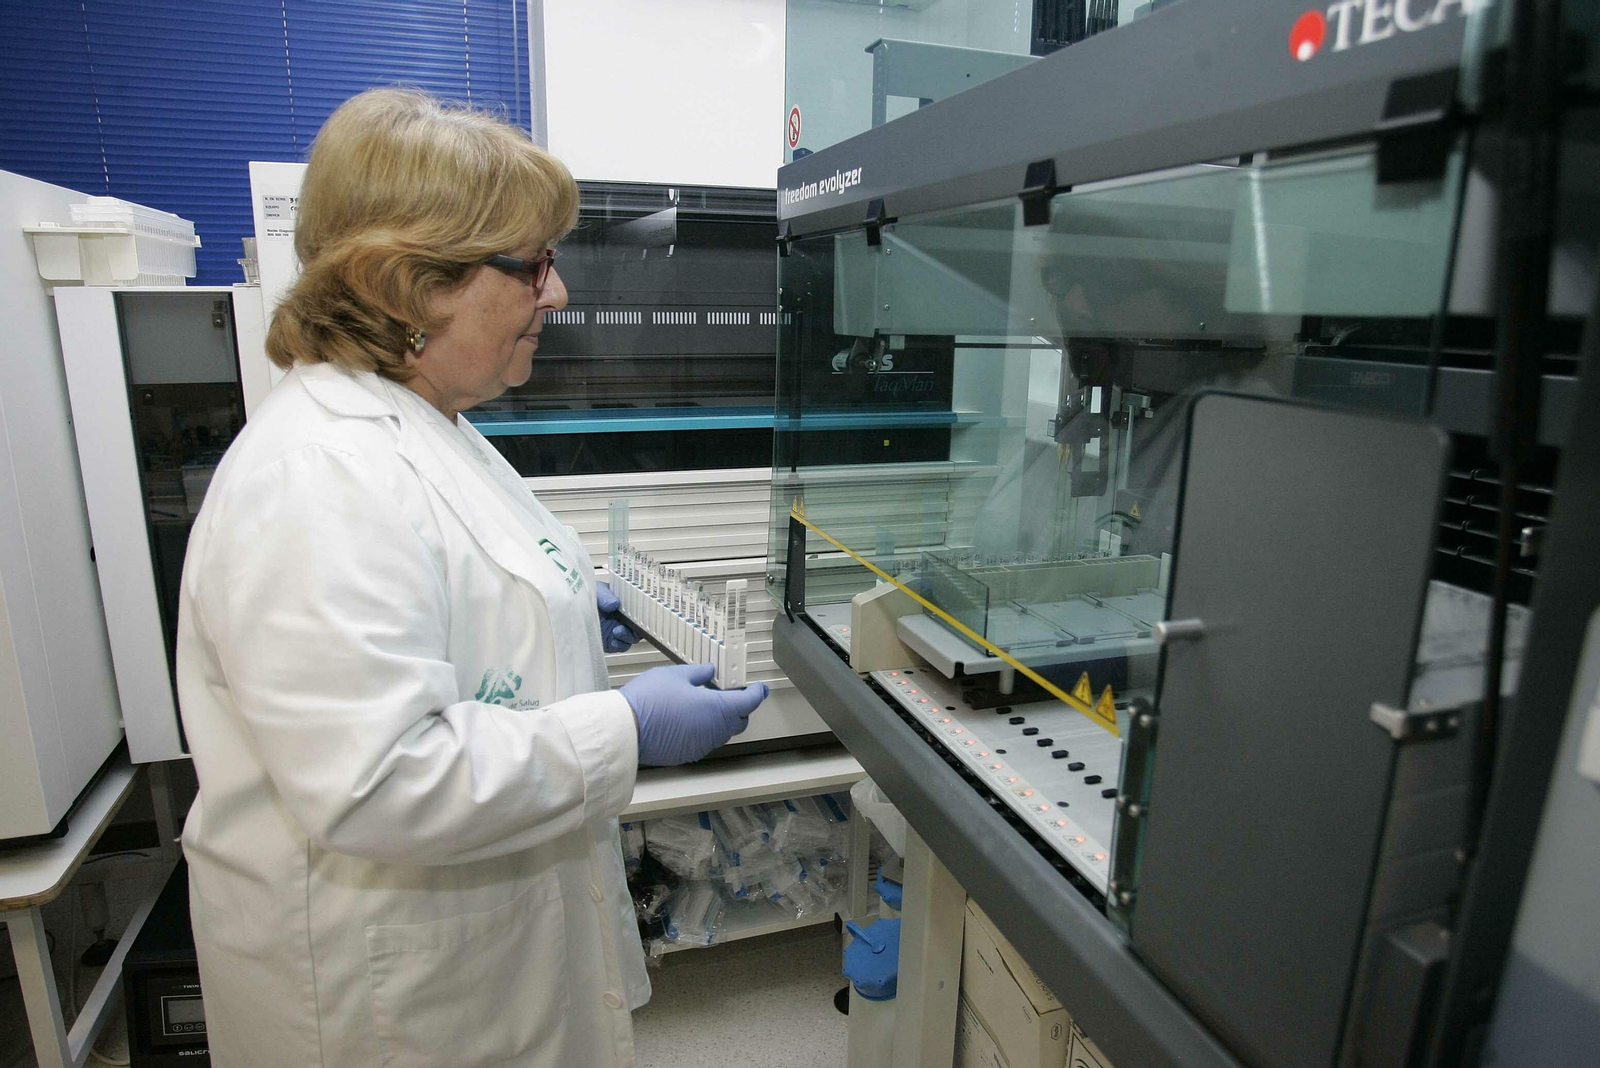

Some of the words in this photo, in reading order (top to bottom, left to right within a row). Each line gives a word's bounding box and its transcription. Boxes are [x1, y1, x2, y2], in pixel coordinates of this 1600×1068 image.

[785, 182, 818, 205] freedom
[819, 167, 863, 195] evolyzer
[874, 375, 934, 395] TaqMan
[519, 699, 540, 707] Salud
